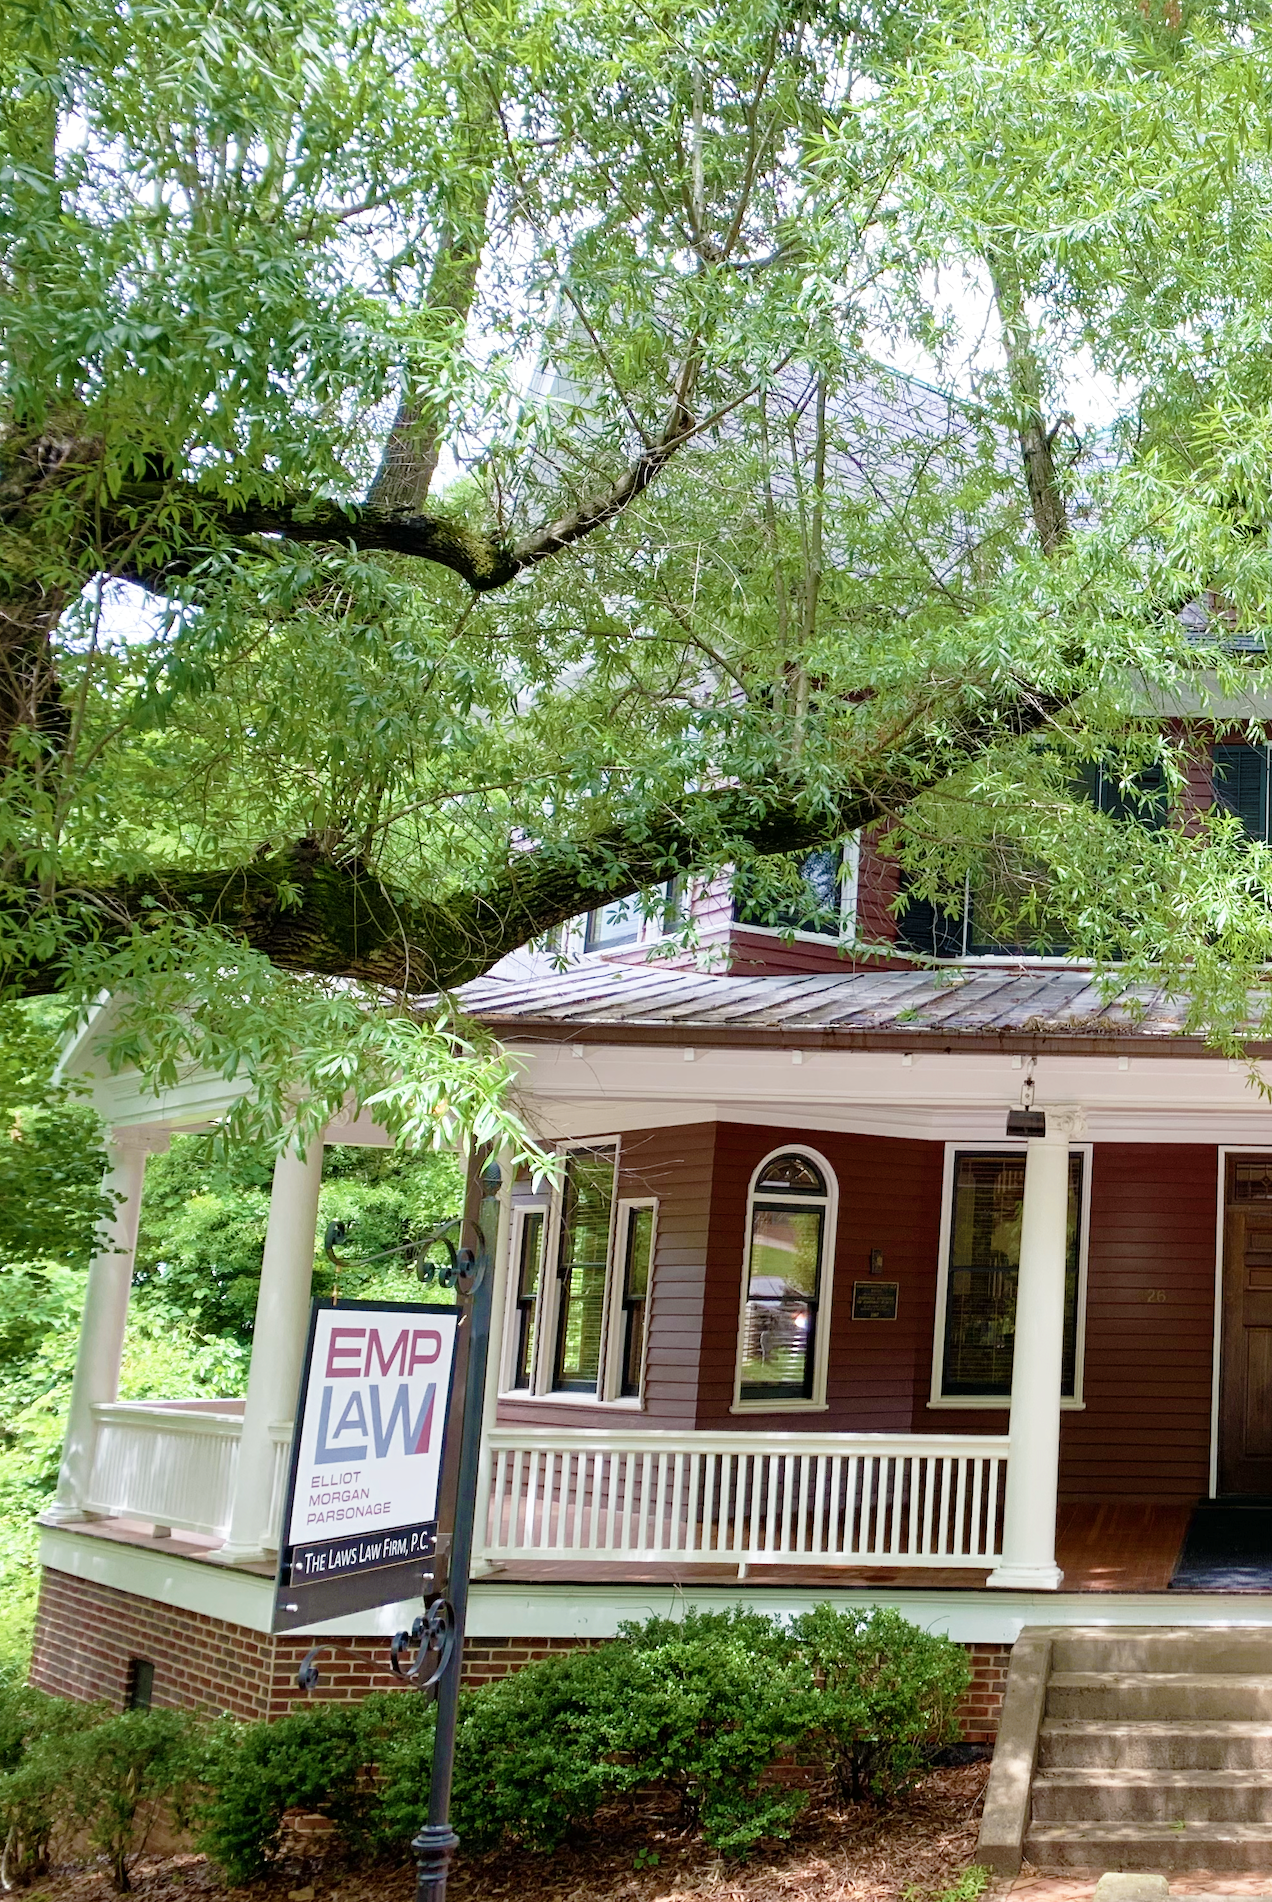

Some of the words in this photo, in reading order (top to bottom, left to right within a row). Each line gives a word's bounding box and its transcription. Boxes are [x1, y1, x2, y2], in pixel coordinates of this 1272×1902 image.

[325, 1328, 442, 1378] EMP
[314, 1382, 437, 1465] LAW
[311, 1471, 361, 1488] ELLIOT
[308, 1488, 370, 1507] MORGAN
[306, 1502, 391, 1525] PARSONAGE
[410, 1531, 429, 1553] P.C.
